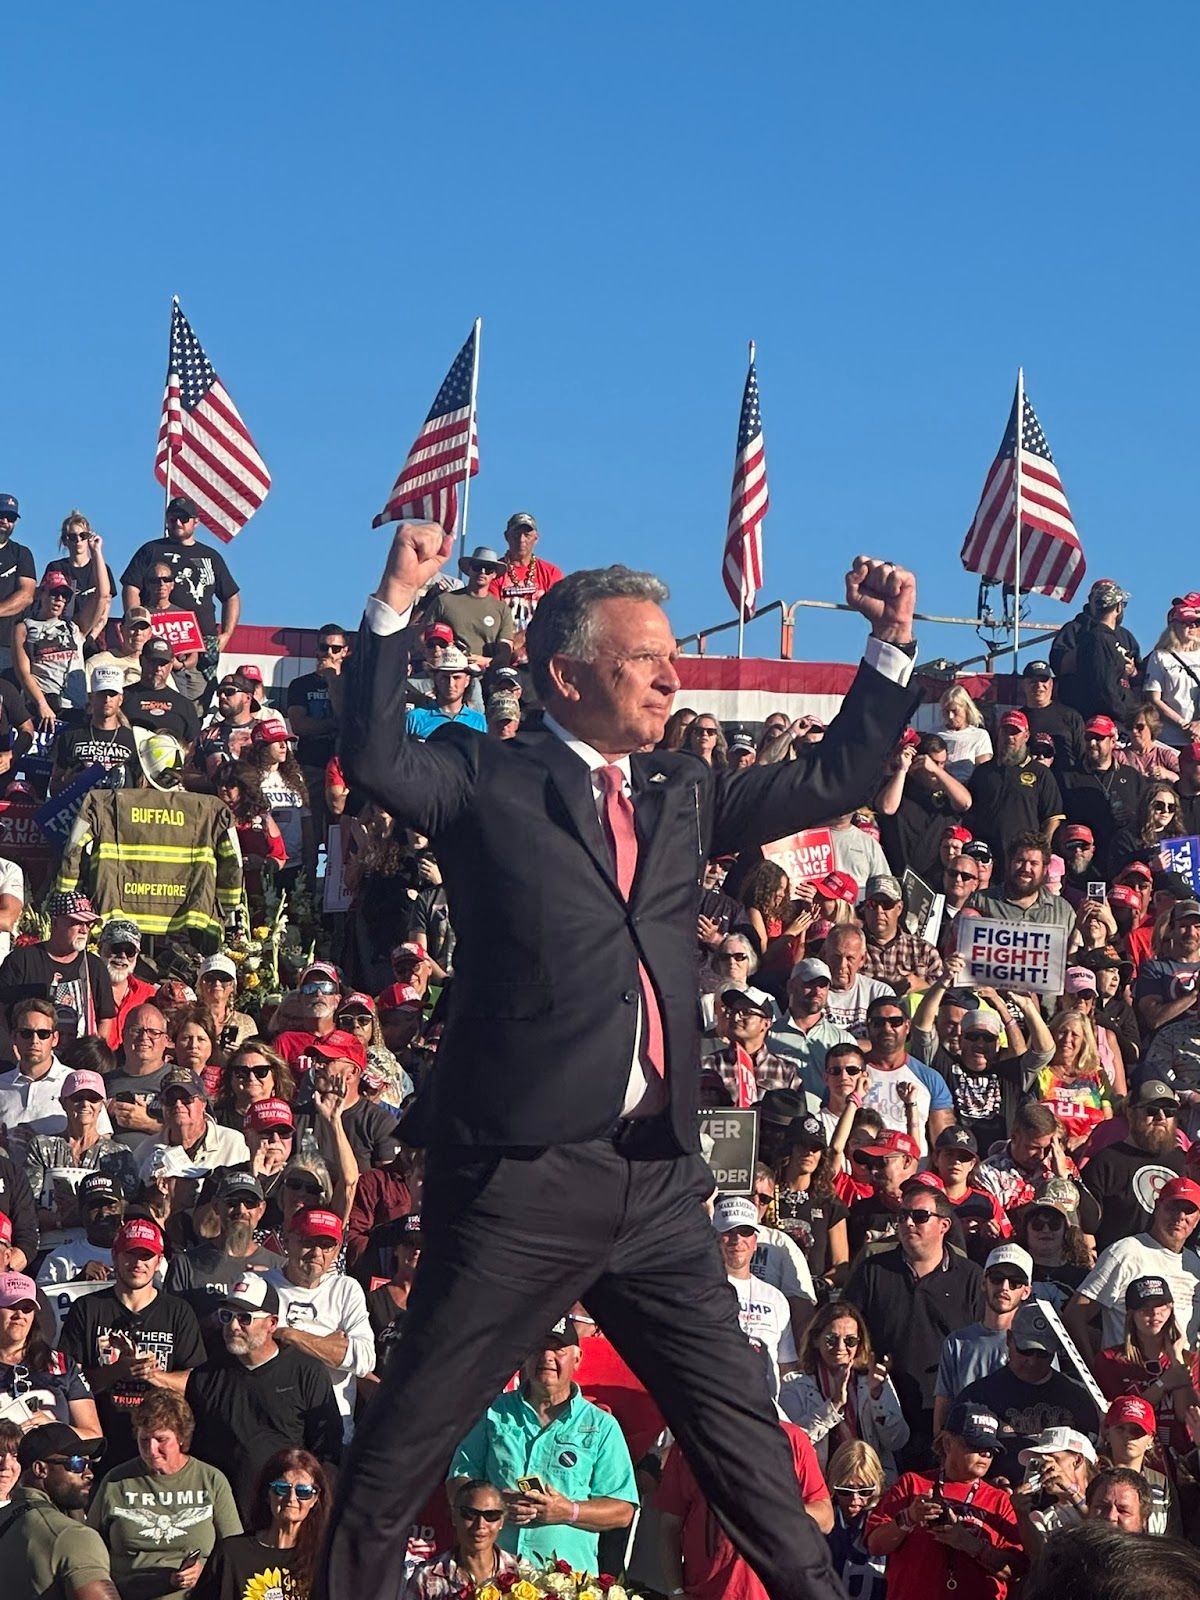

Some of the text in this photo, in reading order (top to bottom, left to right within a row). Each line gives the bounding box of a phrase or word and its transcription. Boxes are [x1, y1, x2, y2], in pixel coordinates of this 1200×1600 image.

[150, 621, 194, 635] UMP
[75, 745, 130, 759] PERSIANS
[92, 755, 111, 763] FOR
[131, 807, 185, 826] BUFFALO
[791, 859, 829, 877] ANCE
[124, 882, 187, 897] COMPERTORE
[973, 927, 1051, 949] FIGHT!
[971, 945, 1050, 967] FIGHT!
[970, 963, 1049, 984] FIGHT!
